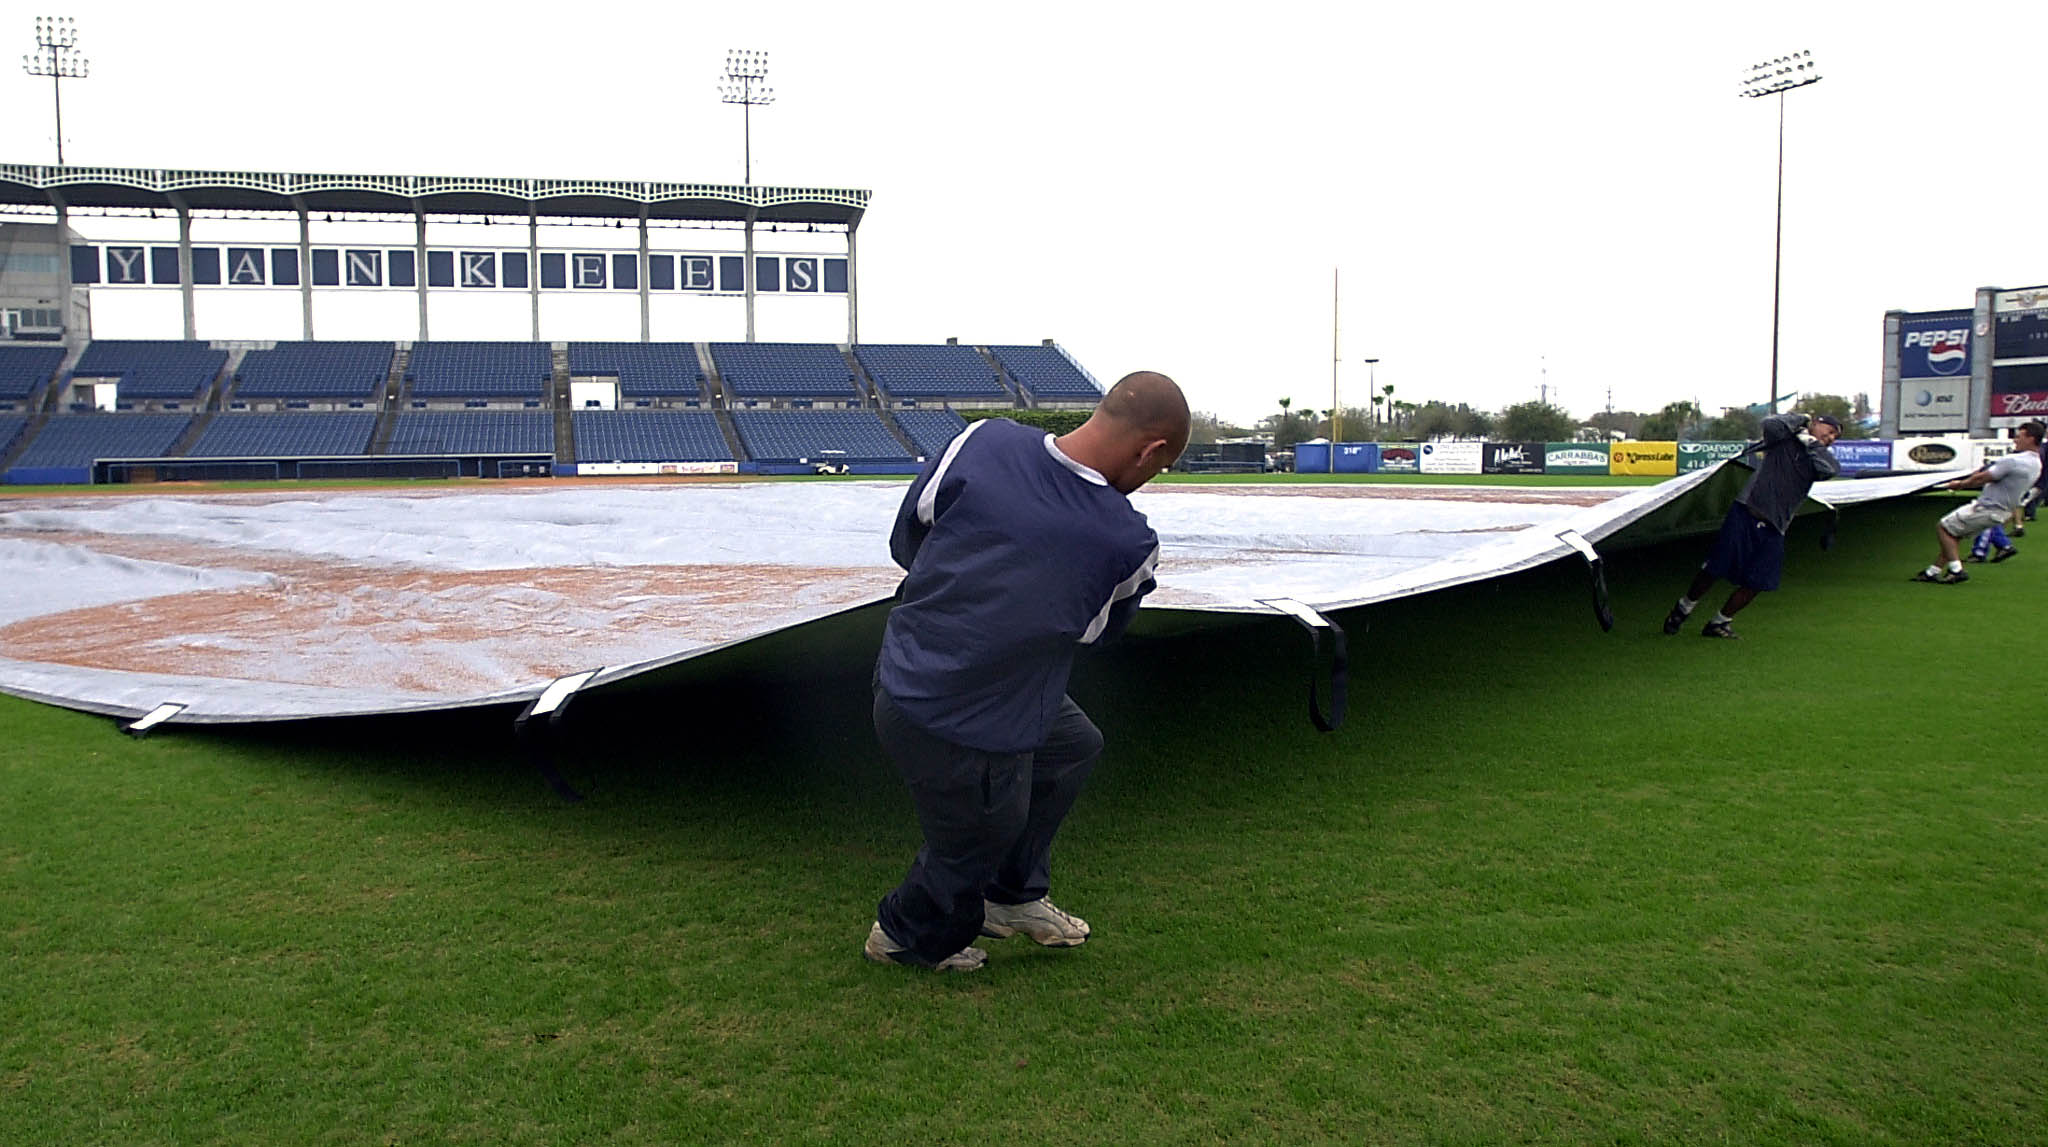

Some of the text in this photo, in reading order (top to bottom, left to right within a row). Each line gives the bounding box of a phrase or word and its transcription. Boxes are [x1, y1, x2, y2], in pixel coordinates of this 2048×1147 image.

[109, 249, 813, 290] YANKEES
[1904, 329, 1970, 348] PEPSI
[1702, 443, 1744, 453] DAEWOO
[1547, 451, 1606, 463] CARRABBA'S
